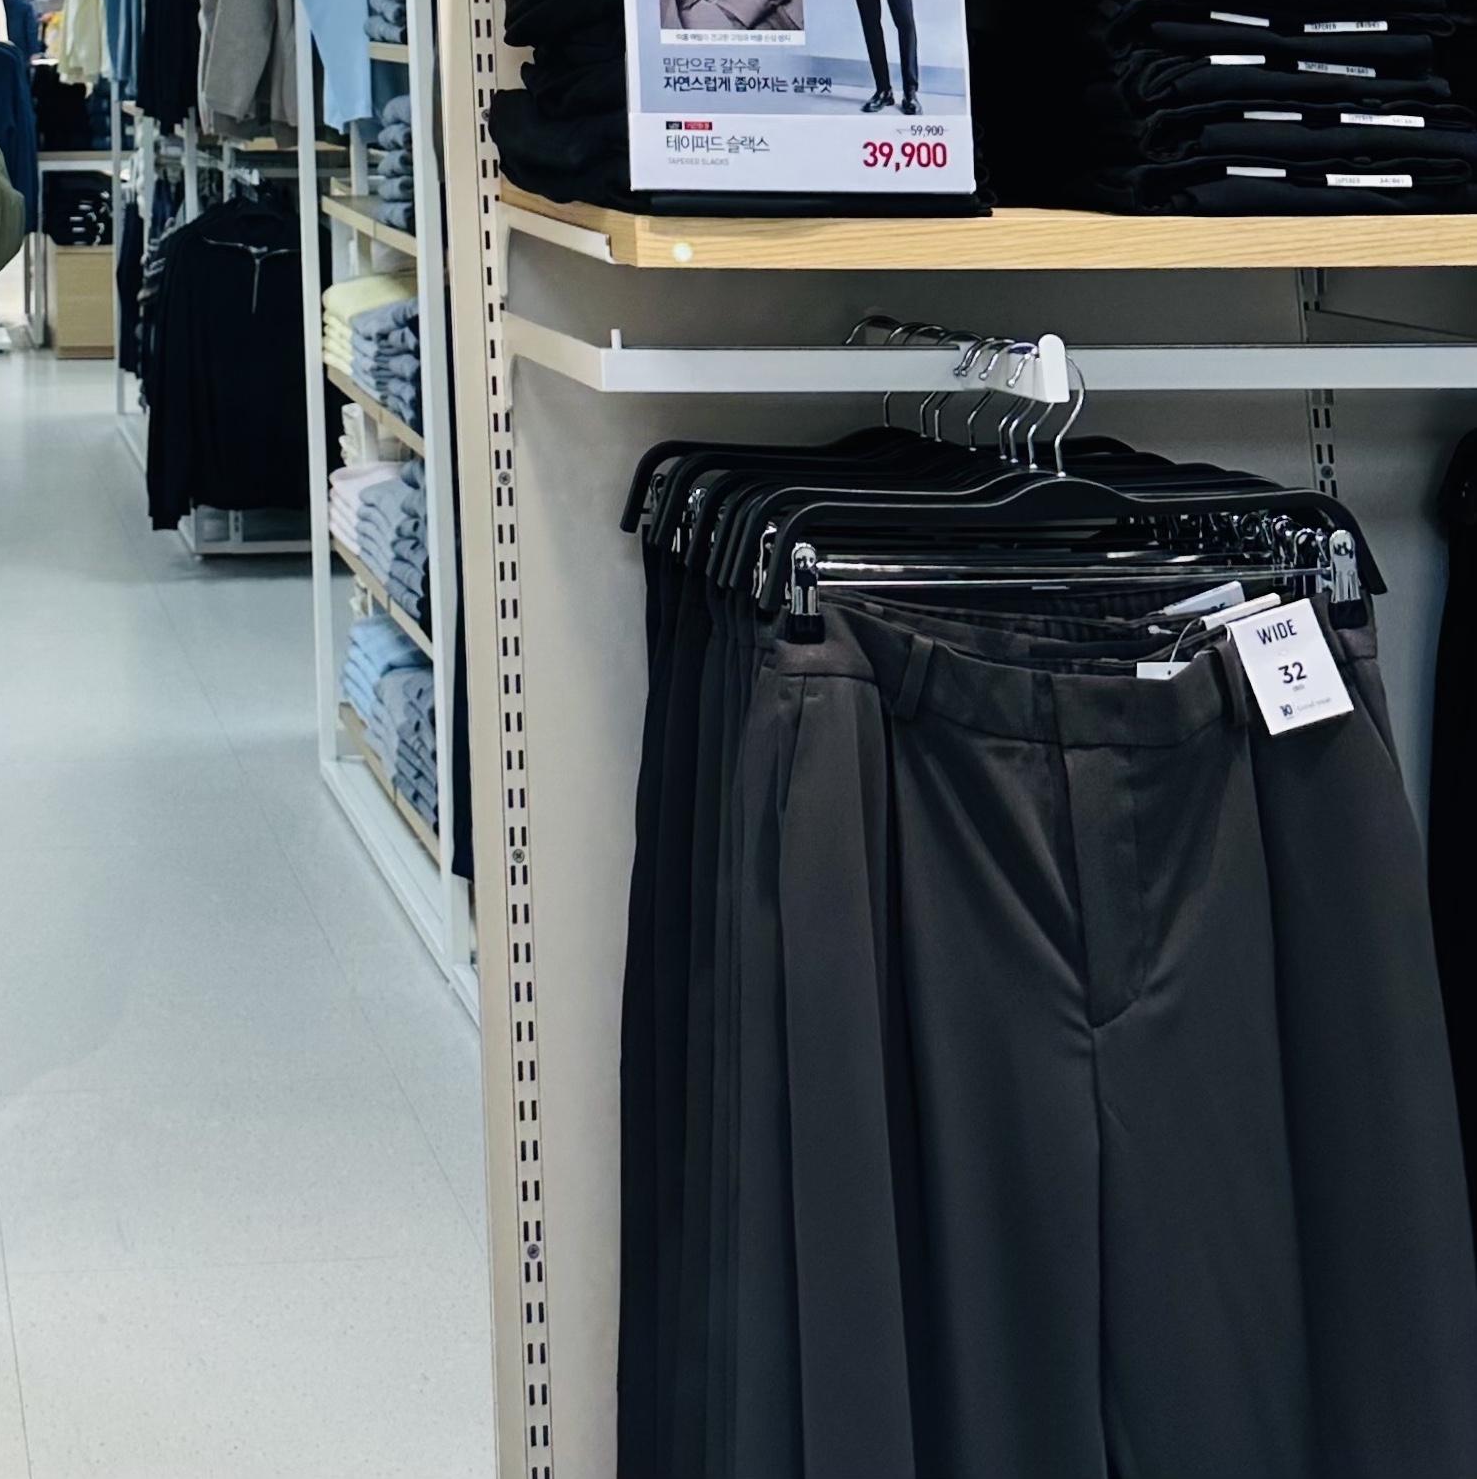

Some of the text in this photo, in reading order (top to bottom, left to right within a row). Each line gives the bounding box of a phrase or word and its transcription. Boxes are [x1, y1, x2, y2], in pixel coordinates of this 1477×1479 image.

[663, 57, 761, 74] 밑단으로 갈수록
[663, 76, 833, 94] 자연스럽게 좁아지는 실루엣
[910, 124, 944, 137] 59,900
[666, 135, 771, 154] 테이퍼드 슬랙스
[862, 142, 947, 172] 39,900
[1256, 619, 1298, 646] WIDE
[1278, 662, 1307, 684] 32
